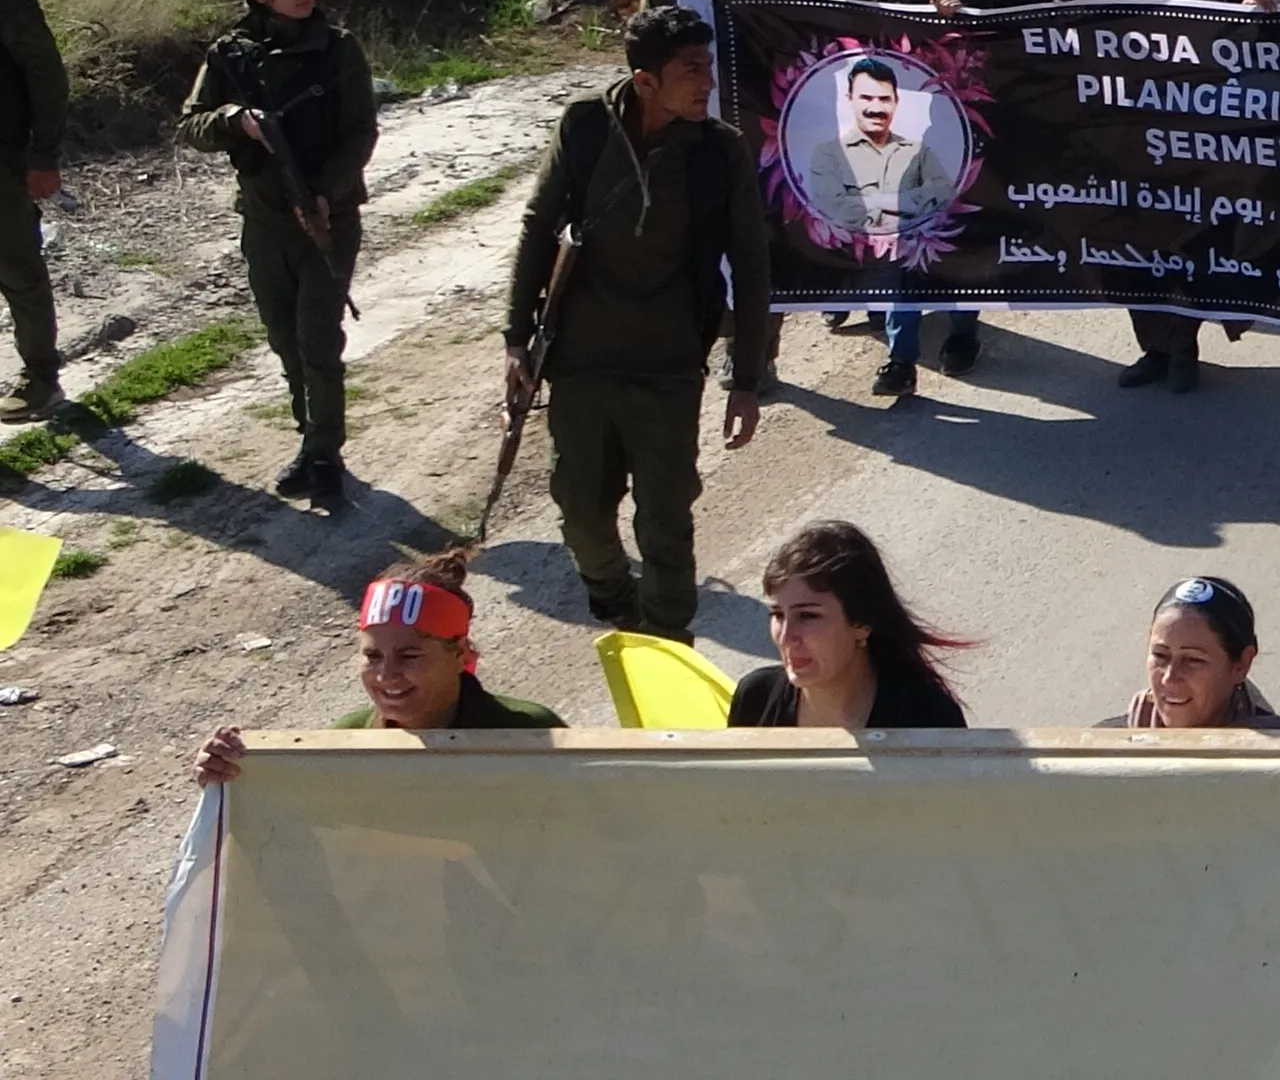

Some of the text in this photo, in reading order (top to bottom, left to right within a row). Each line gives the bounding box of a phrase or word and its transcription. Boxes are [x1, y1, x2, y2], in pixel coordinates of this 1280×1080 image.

[1022, 27, 1080, 56] EM
[1095, 29, 1201, 65] ROJA
[1007, 175, 1128, 209] الشعوب
[1136, 181, 1202, 223] إبادة
[1210, 196, 1263, 226] يوم
[366, 582, 424, 626] APO
